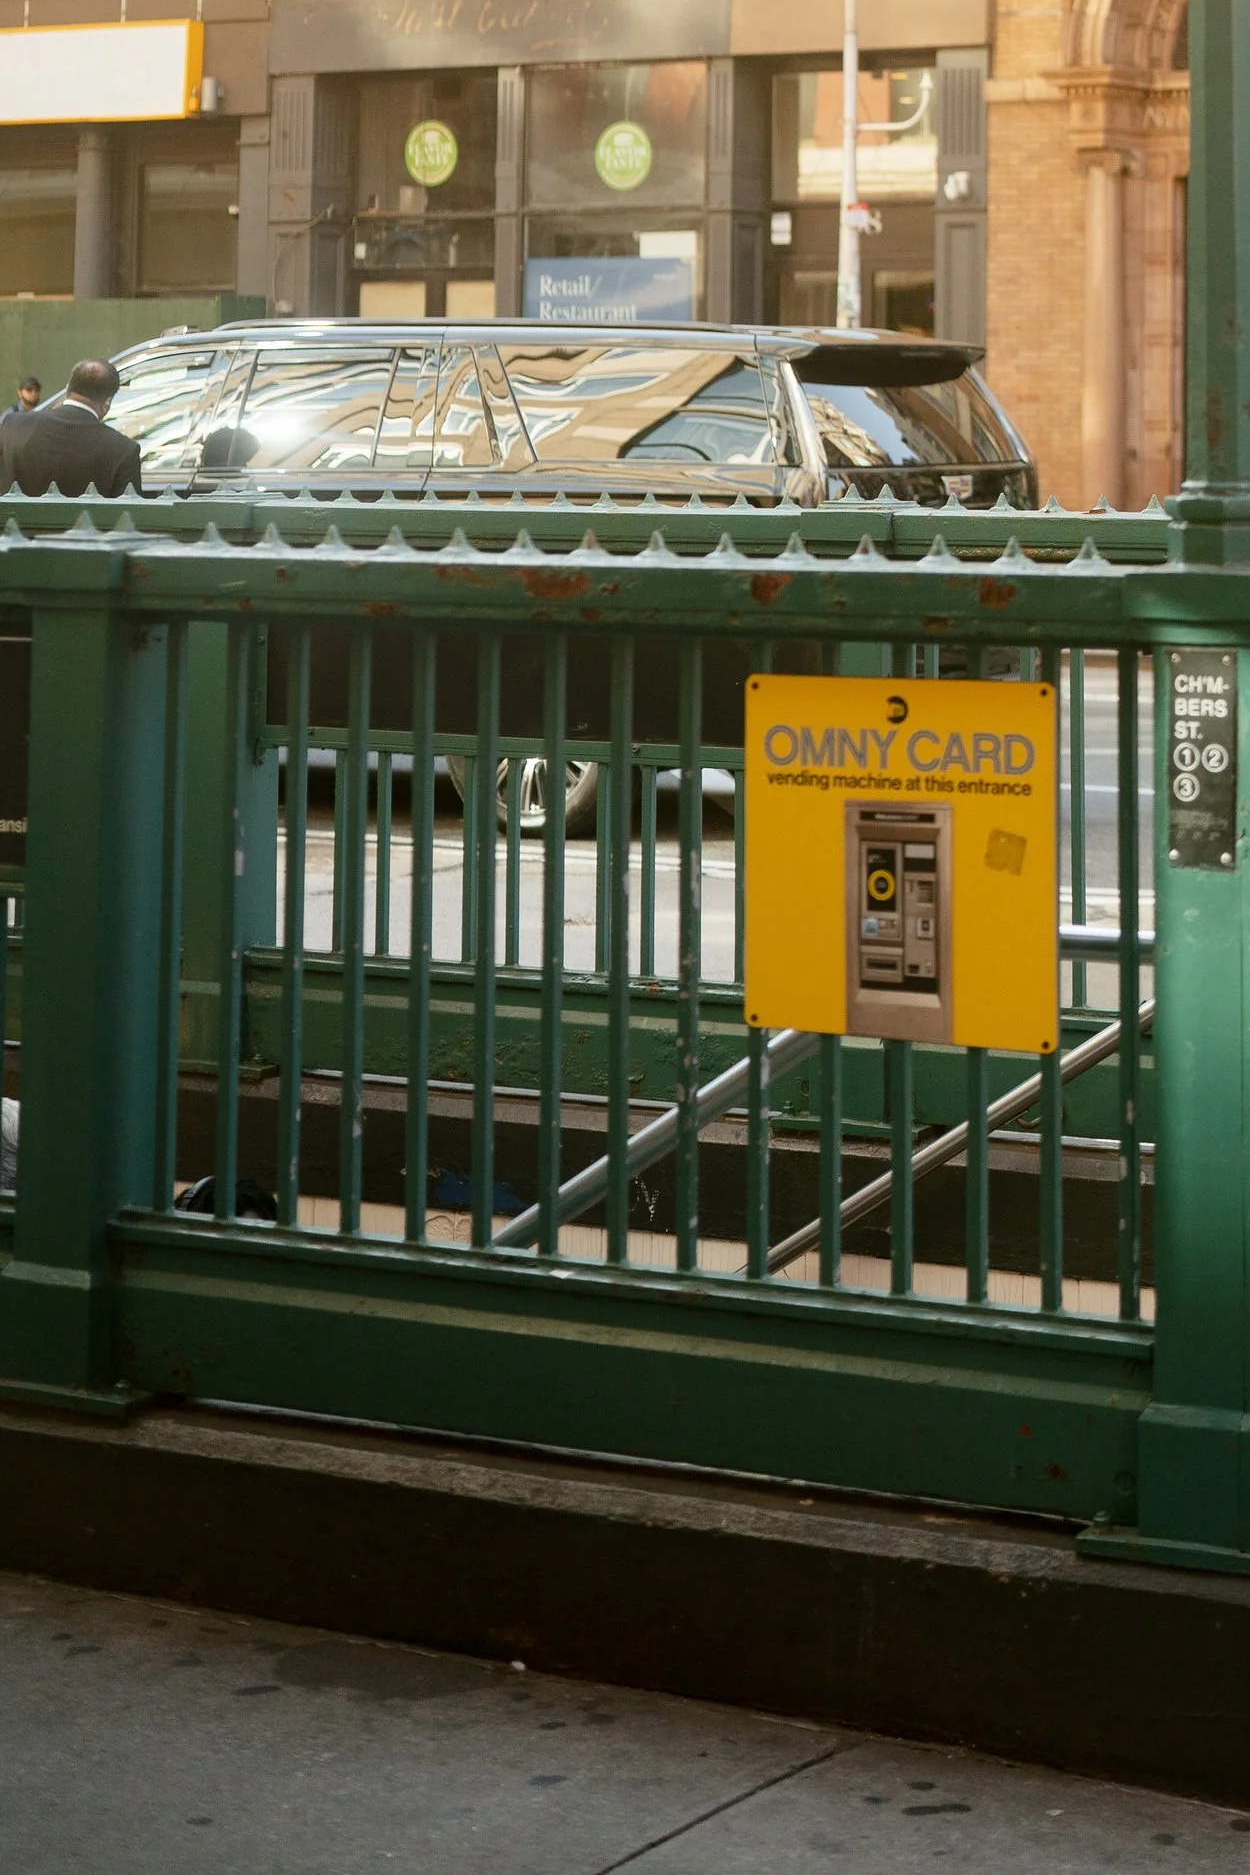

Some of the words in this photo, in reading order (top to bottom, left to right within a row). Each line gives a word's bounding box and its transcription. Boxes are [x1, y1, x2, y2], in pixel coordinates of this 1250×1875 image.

[540, 301, 637, 320] Restaurant
[1174, 698, 1228, 718] BERS
[1174, 720, 1203, 740] ST.
[764, 725, 897, 769] OMNY
[906, 730, 1035, 775] CARD
[767, 770, 830, 790] vending
[832, 774, 900, 791] machine
[905, 775, 920, 792] at
[926, 776, 954, 793] this
[958, 781, 1032, 796] entrance
